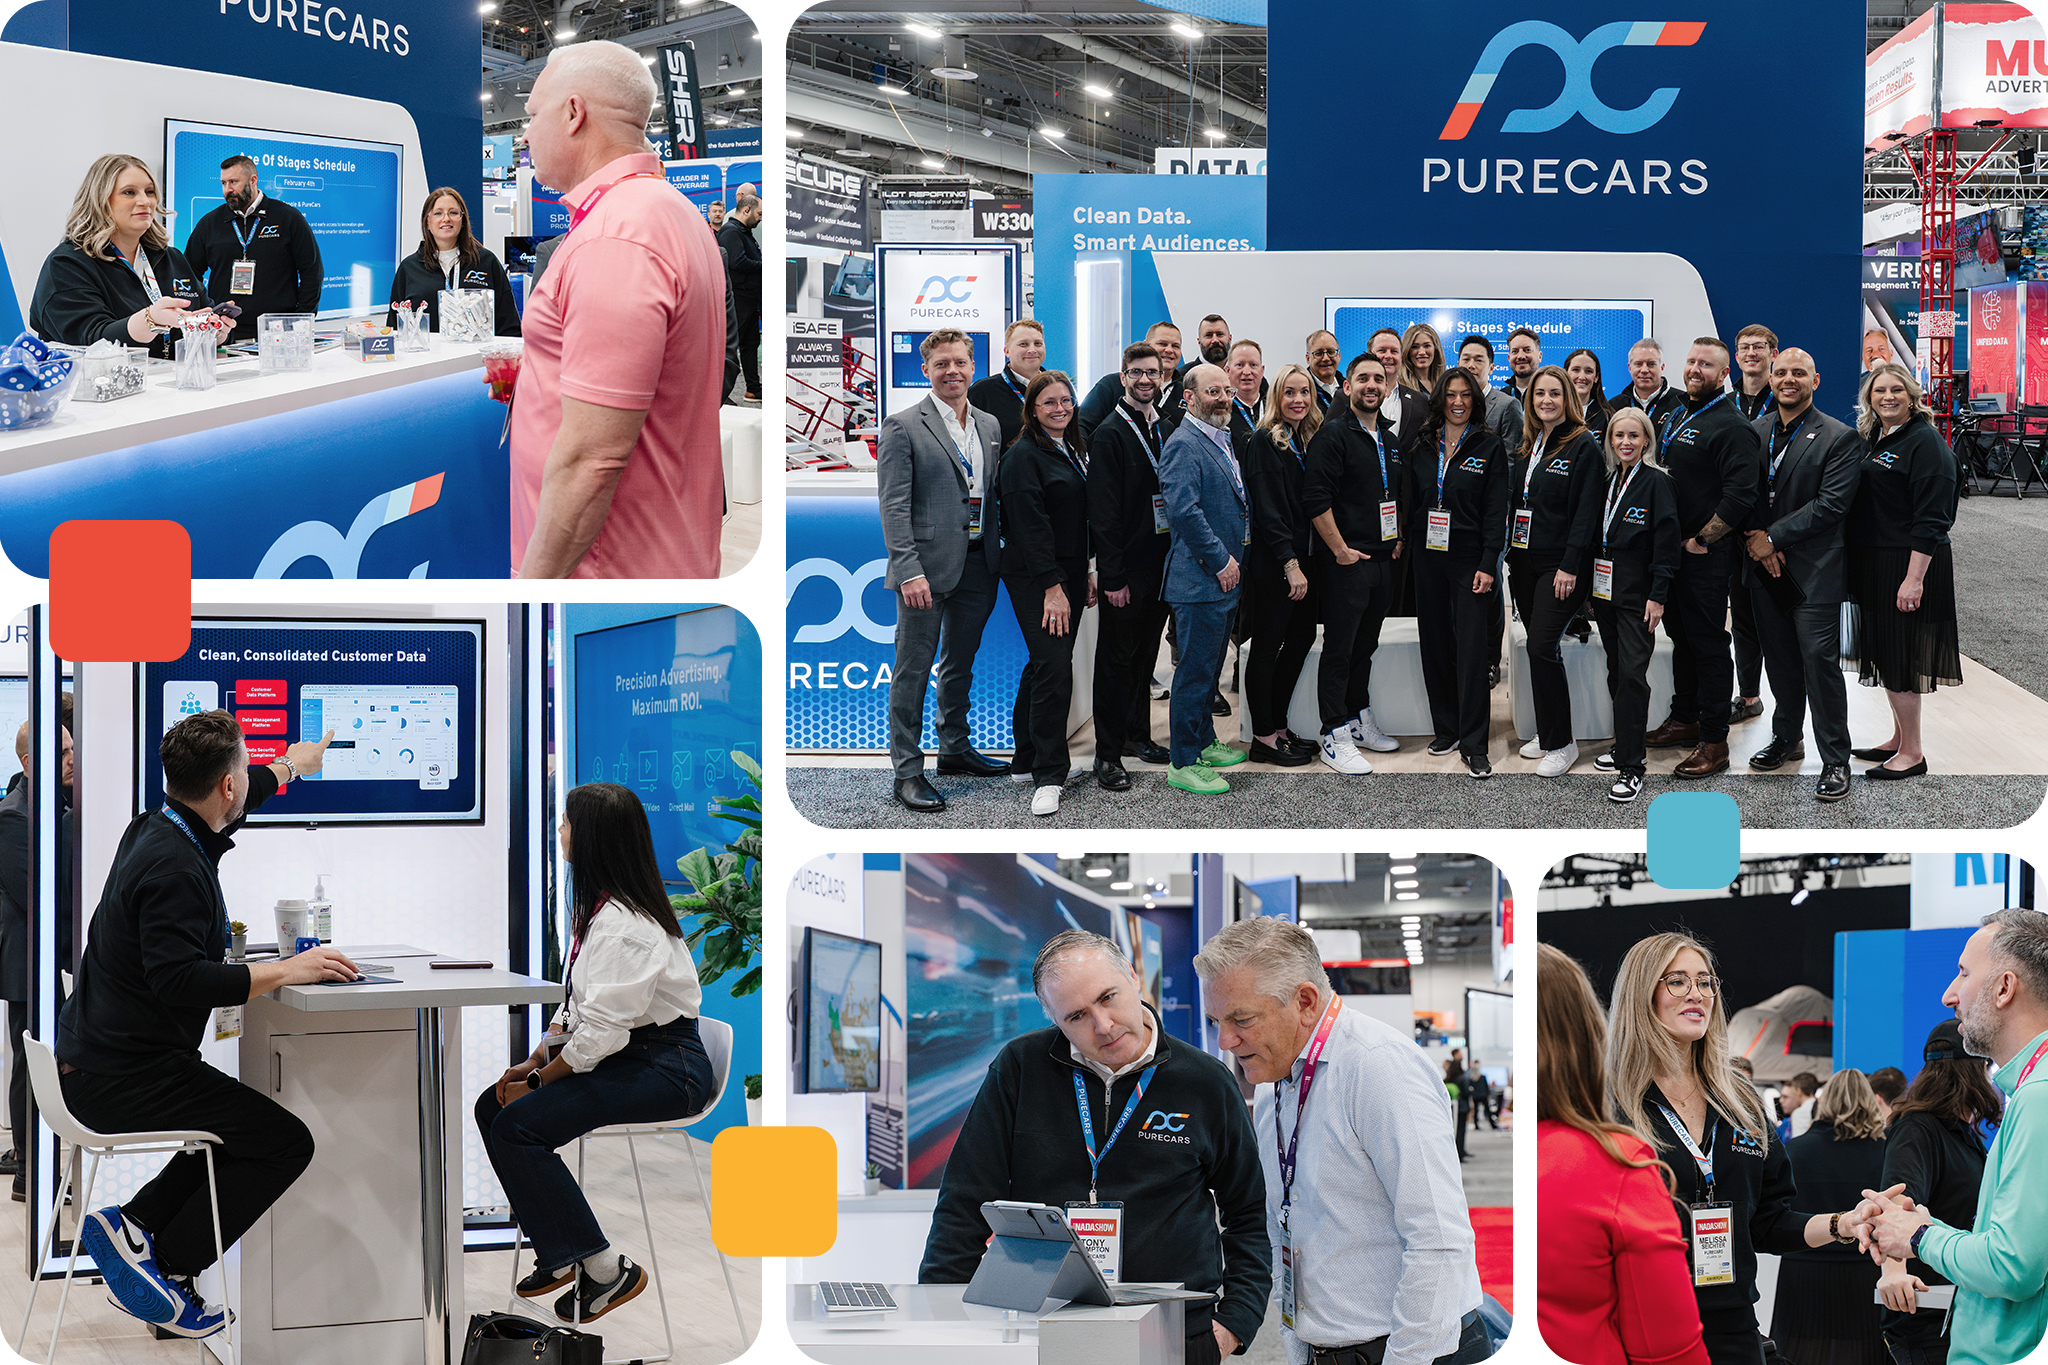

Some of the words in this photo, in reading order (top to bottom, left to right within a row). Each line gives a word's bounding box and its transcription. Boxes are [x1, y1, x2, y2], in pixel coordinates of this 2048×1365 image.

[262, 153, 275, 167] Of
[277, 154, 311, 171] Stages
[313, 157, 356, 173] Schedule
[284, 178, 306, 187] February
[1423, 158, 1709, 195] PURECARS
[908, 190, 967, 198] REPORTING
[1073, 206, 1131, 224] Clean
[1138, 207, 1191, 225] Data.
[1073, 233, 1136, 250] Smart
[1141, 234, 1256, 251] Audiences.
[1862, 281, 1910, 291] anagement
[910, 308, 980, 318] PURECARS
[792, 321, 838, 335] iSAFE
[1456, 321, 1504, 335] Stages
[796, 343, 833, 352] ALWAYS
[1993, 337, 2008, 345] DATA
[790, 354, 840, 363] INNOVATING
[199, 648, 240, 663] Clean,
[243, 648, 328, 662] Consolidated
[331, 650, 393, 662] Customer
[396, 650, 427, 662] Data
[615, 671, 658, 692] Precision
[659, 662, 722, 687] Advertising.
[632, 697, 678, 716] Maximum
[680, 691, 702, 712] ROI.
[668, 802, 683, 812] Direct
[683, 802, 695, 812] Mail
[1078, 1088, 1092, 1135] PURECARS
[1106, 1106, 1133, 1149] PURECARS
[1665, 1110, 1694, 1147] PURECARS
[1138, 1130, 1191, 1145] PURECARS
[1731, 1144, 1763, 1158] PURECARS
[1699, 1235, 1728, 1244] MELISSA
[1701, 1242, 1726, 1250] SEICHTER
